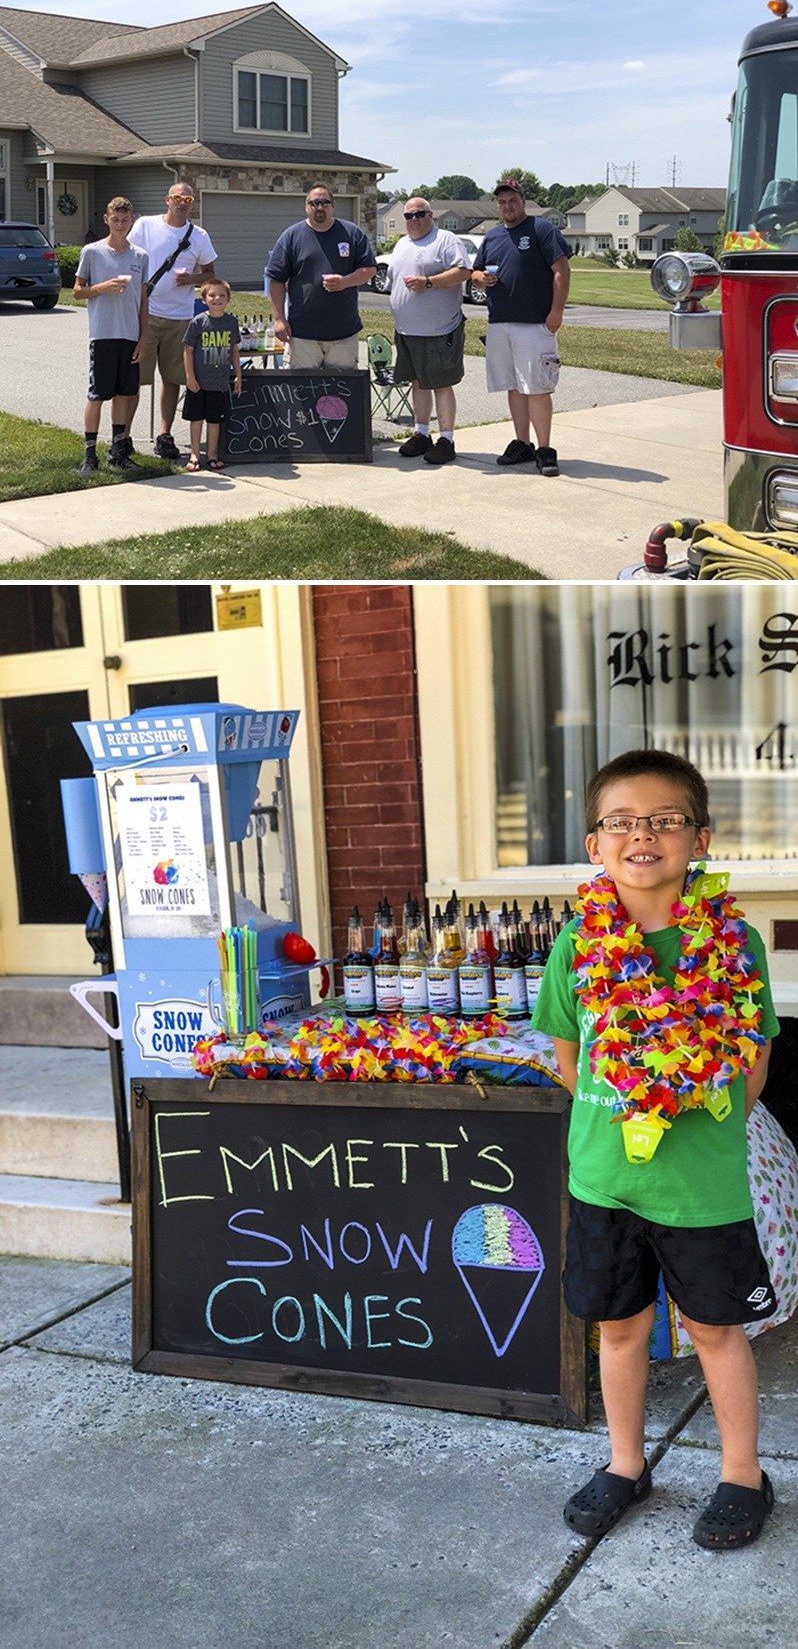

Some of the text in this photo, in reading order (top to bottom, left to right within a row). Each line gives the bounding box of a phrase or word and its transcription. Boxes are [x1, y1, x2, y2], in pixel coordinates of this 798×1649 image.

[201, 331, 232, 348] GAME
[201, 347, 231, 366] TIME
[229, 377, 352, 410] Emmett's
[296, 408, 319, 425] $1
[606, 622, 735, 690] Rick
[106, 729, 188, 746] REFRESHING
[149, 806, 168, 822] $2
[140, 888, 196, 905] SNOW CONES
[153, 1010, 203, 1031] SNOW
[154, 1111, 514, 1207] EMMETT'S
